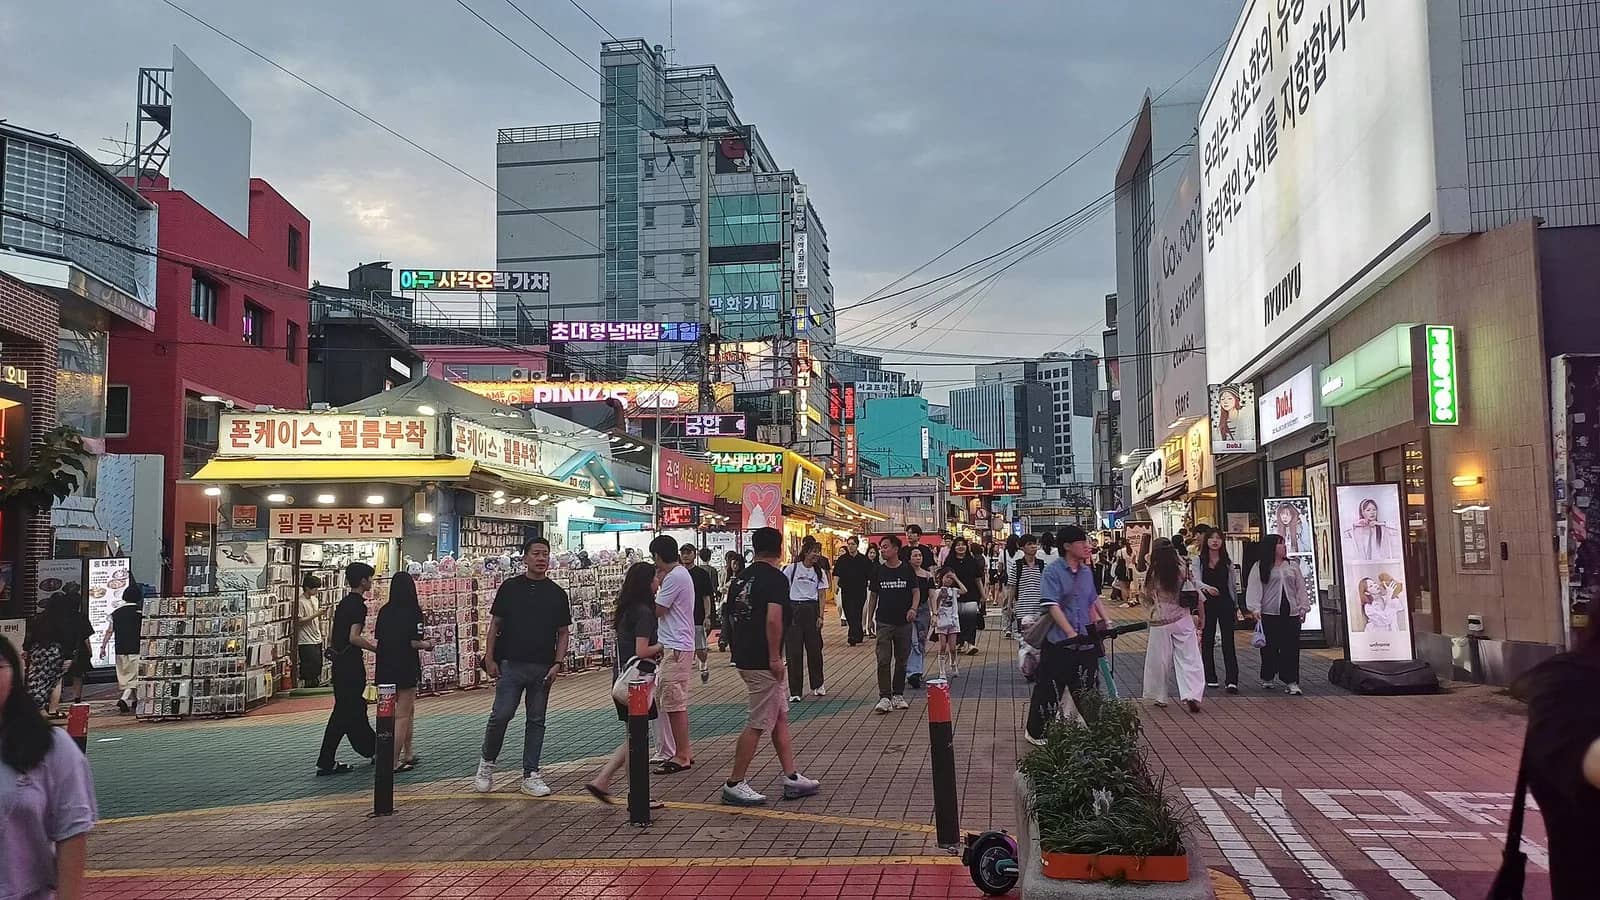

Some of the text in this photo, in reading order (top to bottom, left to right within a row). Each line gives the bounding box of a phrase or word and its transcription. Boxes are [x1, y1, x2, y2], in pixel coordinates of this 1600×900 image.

[1205, 115, 1229, 187] 우리는
[1231, 11, 1274, 135] 최소한의
[1206, 157, 1242, 253] 합리적인
[1244, 96, 1279, 194] 소비를
[401, 271, 434, 288] 야구
[710, 294, 776, 313] 만화카페
[230, 419, 427, 449] 폰케이스 필름부착
